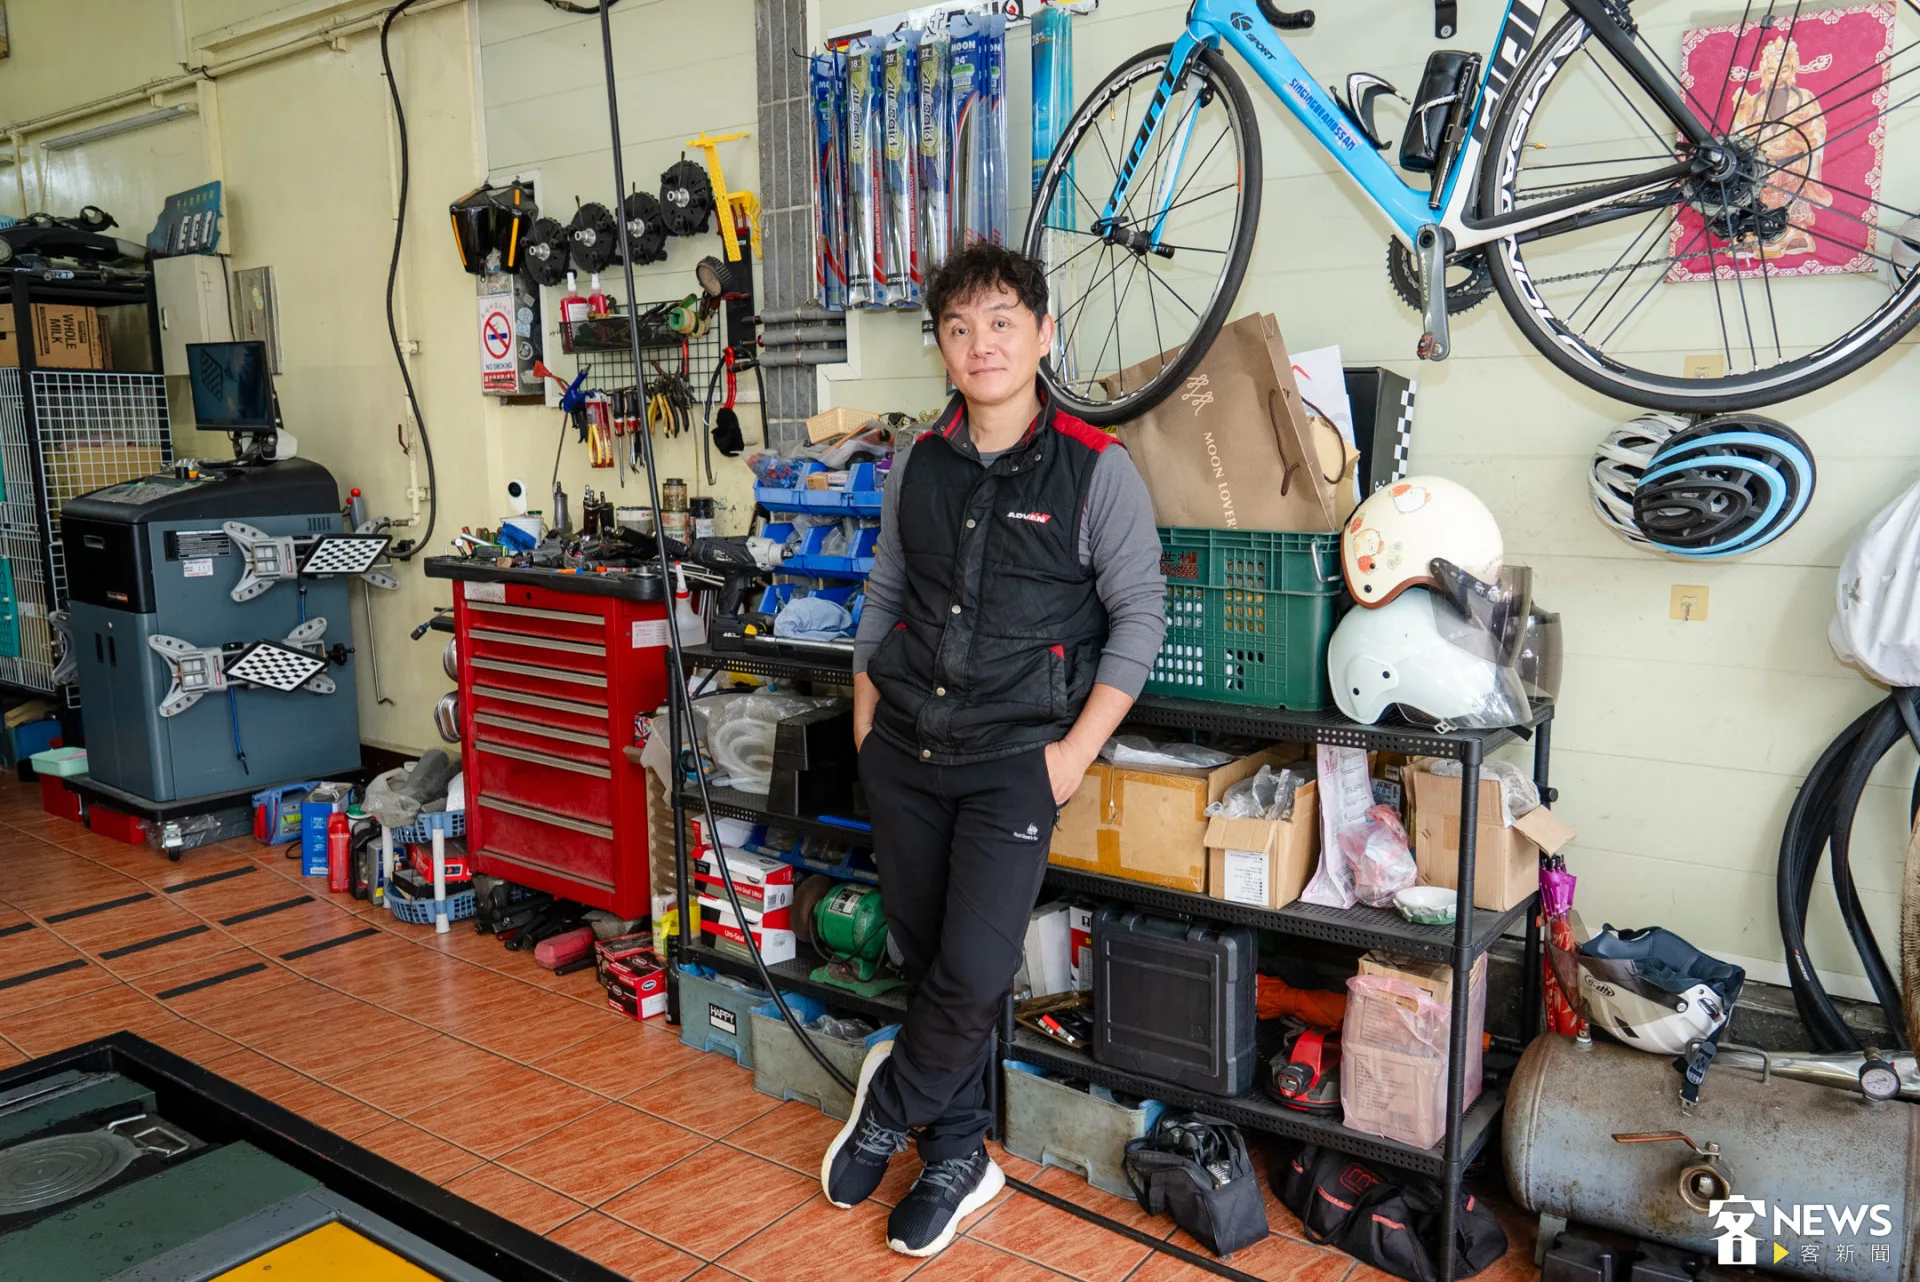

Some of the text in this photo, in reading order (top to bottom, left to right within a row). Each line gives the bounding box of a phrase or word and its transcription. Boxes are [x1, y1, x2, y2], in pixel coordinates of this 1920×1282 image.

[951, 40, 976, 52] MOON
[1245, 33, 1277, 61] SPORT
[1109, 67, 1178, 213] GIANT
[49, 318, 62, 344] MILK
[62, 313, 77, 350] WHOLE
[485, 361, 513, 371] NO SMOKING
[1203, 431, 1239, 530] MOON LOVER
[1006, 511, 1046, 524] ADVAN
[724, 928, 745, 943] Uni-Seal
[710, 1005, 735, 1024] HAPPY
